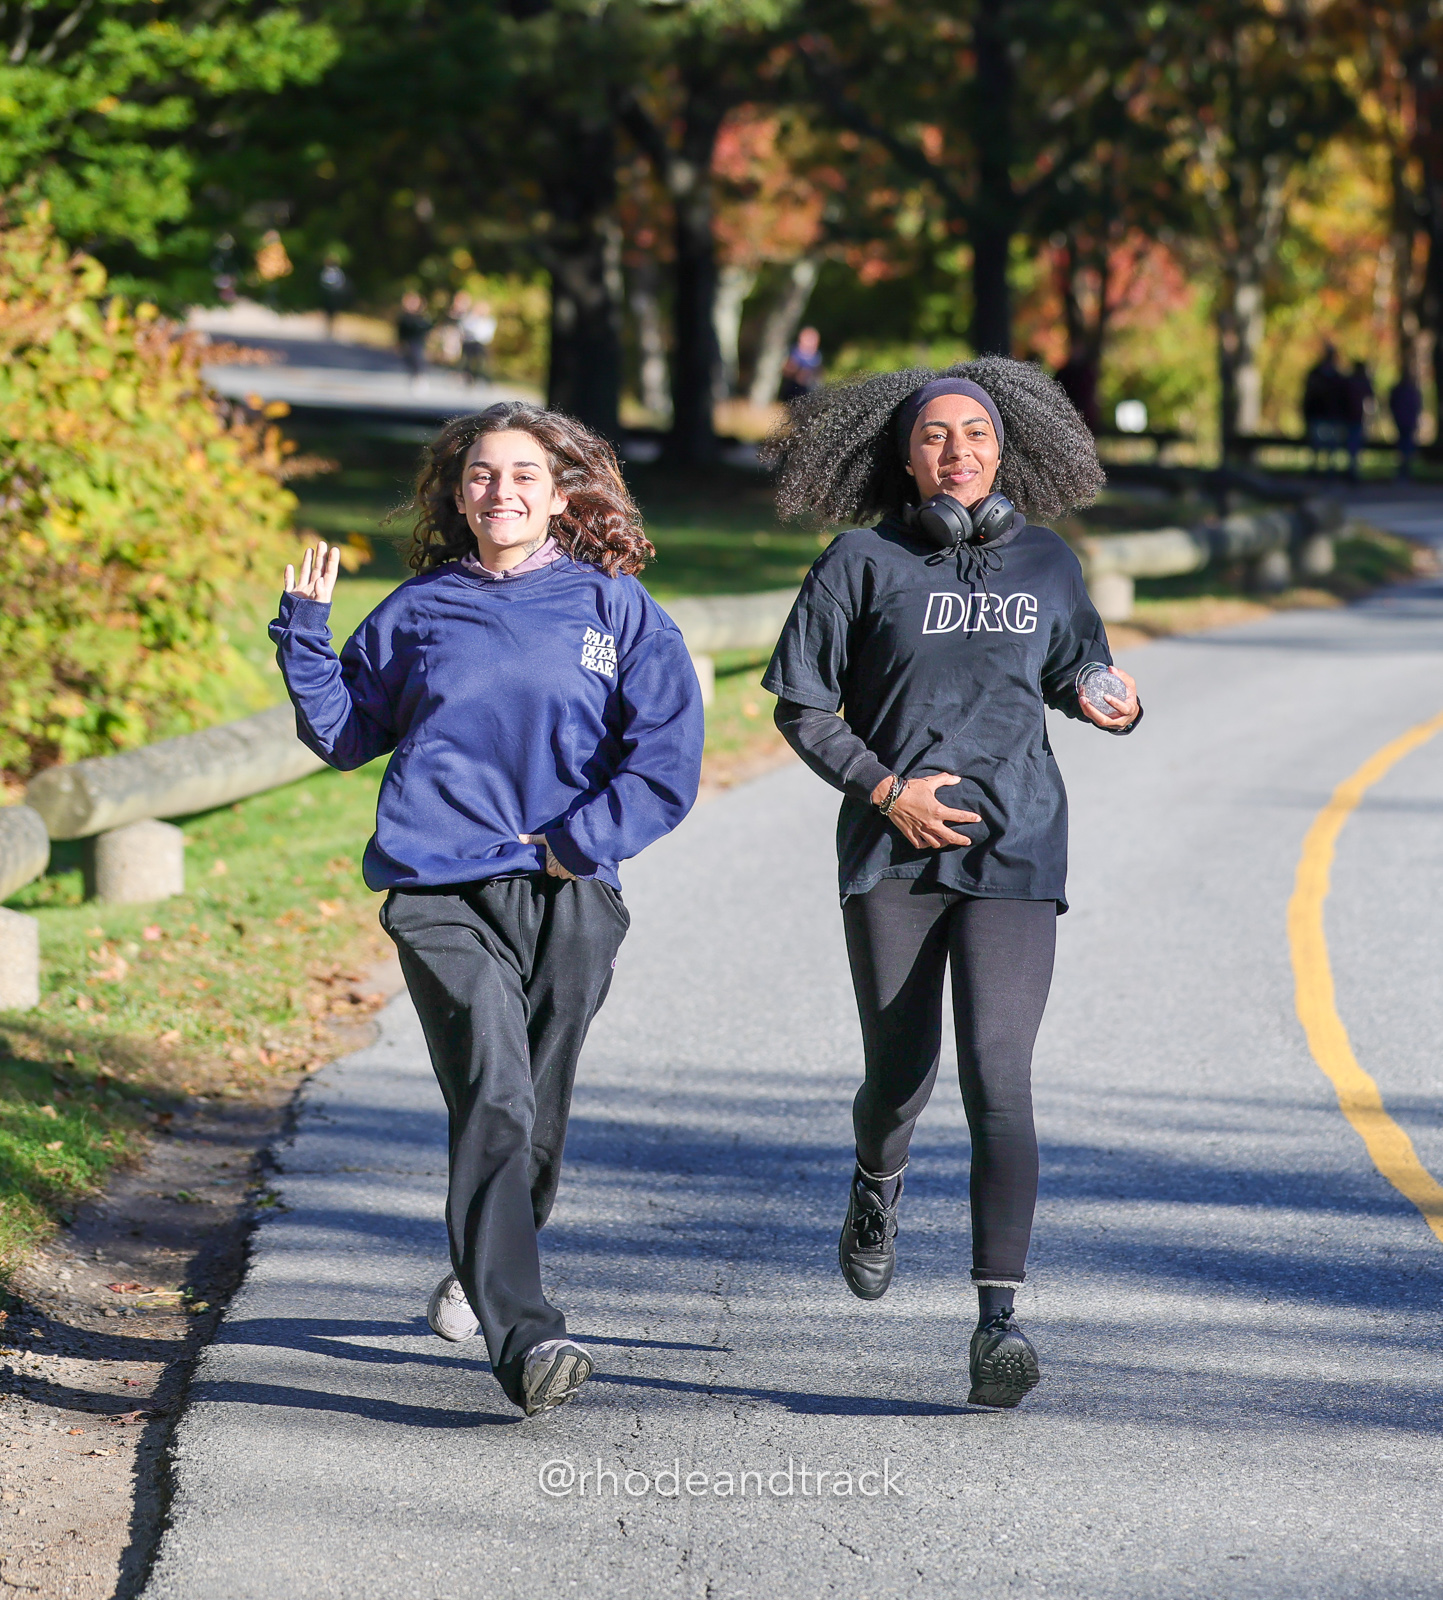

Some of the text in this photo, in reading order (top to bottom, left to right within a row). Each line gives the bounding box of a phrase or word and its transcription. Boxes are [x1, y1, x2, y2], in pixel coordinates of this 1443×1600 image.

[922, 593, 1038, 634] DRC
[582, 626, 616, 649] FAIT
[580, 654, 615, 678] FEAR
